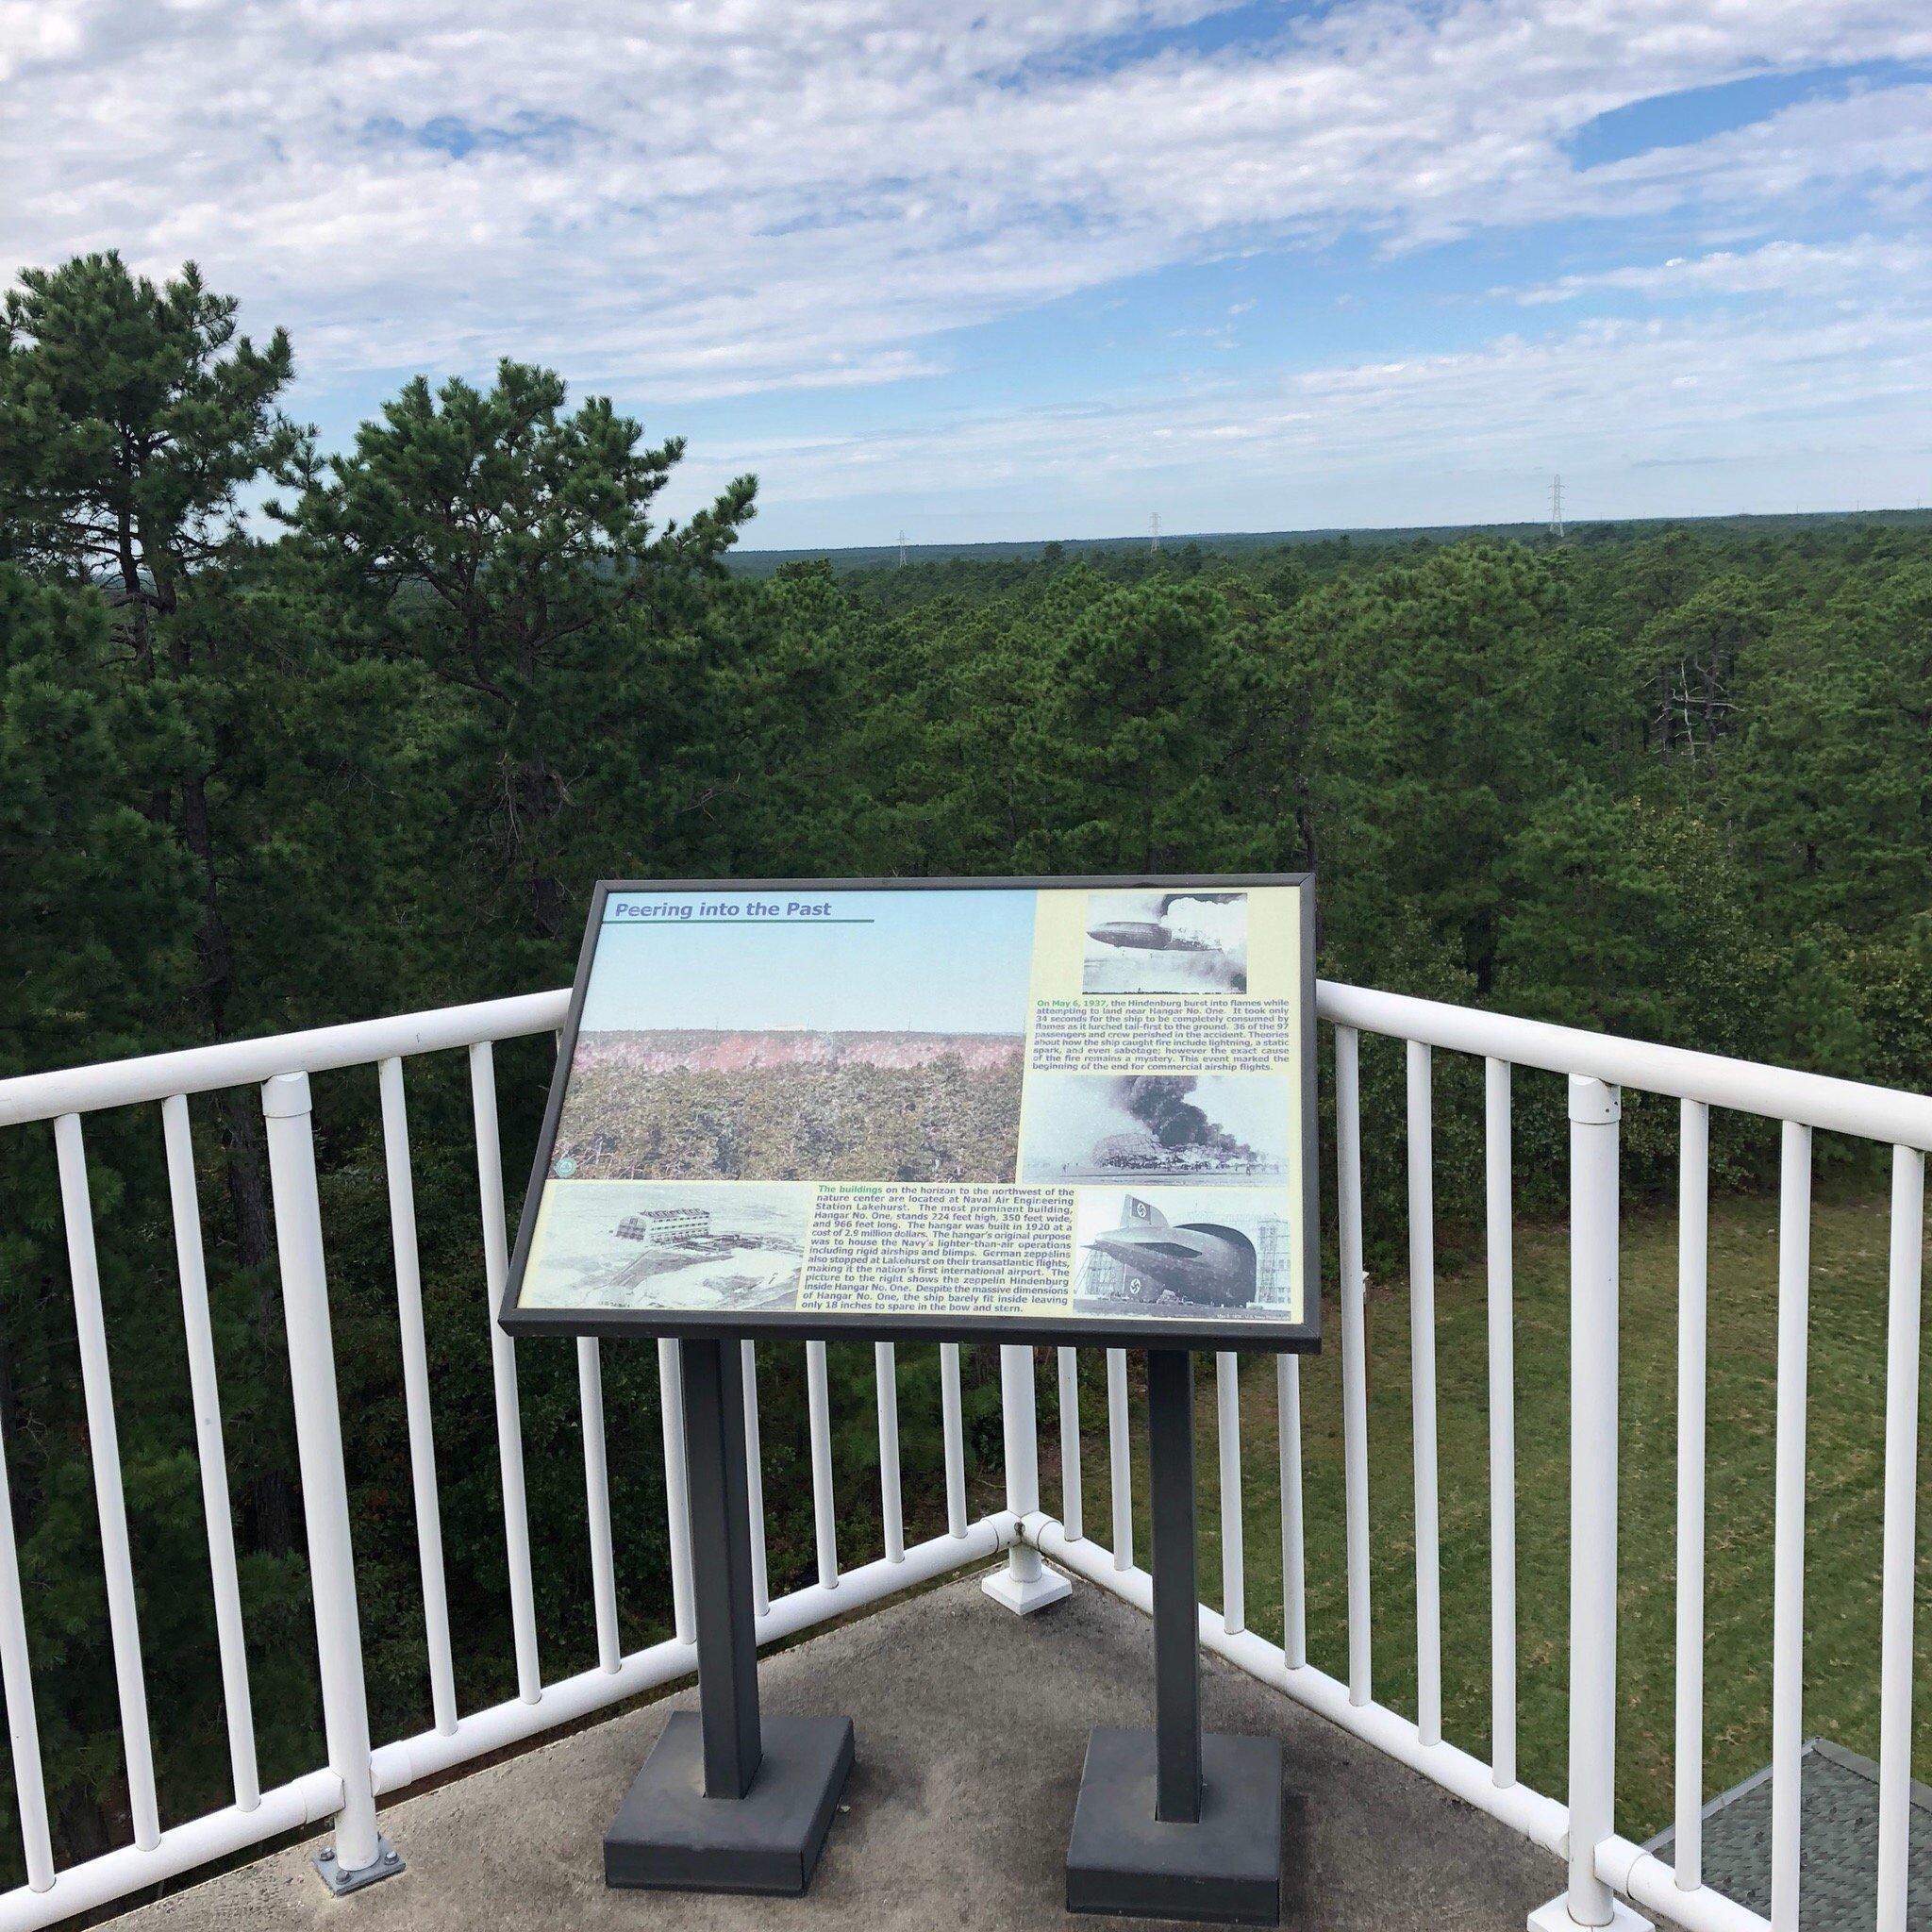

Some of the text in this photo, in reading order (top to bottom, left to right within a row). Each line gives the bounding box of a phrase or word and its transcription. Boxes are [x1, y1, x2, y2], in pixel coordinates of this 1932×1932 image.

[615, 901, 831, 920] Peering into the Past
[1053, 999, 1071, 1008] May
[1073, 999, 1081, 1008] 6,
[1084, 999, 1108, 1008] 1937,
[1128, 999, 1181, 1008] Hindenburg
[1036, 1007, 1087, 1016] attempting
[1150, 1007, 1183, 1016] Hangar
[1269, 1007, 1289, 1016] only
[1124, 1015, 1142, 1024] ship
[1173, 1015, 1224, 1024] completely
[1133, 1030, 1172, 1040] perished
[1101, 1039, 1120, 1047] ship
[1123, 1039, 1154, 1047] caught
[1033, 1046, 1064, 1056] spark,
[1114, 1046, 1163, 1056] sabotage;
[1135, 1054, 1175, 1063] mystery.
[1033, 1062, 1078, 1072] beginning
[1205, 1062, 1237, 1072] airship
[1240, 1063, 1273, 1072] flights.
[820, 1185, 1041, 1195] The buildings horizon northwest
[817, 1193, 849, 1202] nature
[909, 1194, 944, 1203] located
[963, 1195, 991, 1204] Naval
[1014, 1196, 1074, 1207] Engineering
[816, 1202, 852, 1210] Station
[857, 1203, 911, 1211] Lakehurst.
[970, 1204, 1024, 1215] prominent
[1028, 1205, 1074, 1215] building,
[815, 1211, 849, 1221] Hangar
[872, 1211, 892, 1222] One,
[932, 1212, 949, 1221] 224
[953, 1212, 972, 1221] feet
[975, 1213, 998, 1223] high,
[1024, 1213, 1042, 1222] feet
[1046, 1214, 1073, 1224] wide,
[835, 1220, 852, 1228] 966
[856, 1220, 874, 1228] feet
[877, 1221, 901, 1230] long.
[908, 1221, 924, 1229] The
[928, 1221, 962, 1231] hangar
[988, 1222, 1009, 1230] built
[812, 1228, 831, 1237] cost
[894, 1229, 929, 1238] dollars.
[994, 1231, 1030, 1241] original
[1033, 1233, 1071, 1241] purpose
[848, 1238, 877, 1246] house
[938, 1239, 1014, 1250] lighter-than-air
[1018, 1240, 1071, 1250] operations
[809, 1246, 853, 1257] including
[857, 1247, 878, 1257] rigid
[880, 1247, 919, 1257] airships
[942, 1248, 977, 1258] blimps.
[830, 1256, 868, 1266] stopped
[882, 1257, 930, 1265] Lakehurst
[972, 1257, 1034, 1266] transatlantic
[1037, 1258, 1070, 1269] flights,
[808, 1264, 842, 1274] making
[941, 1266, 1004, 1274] international
[1008, 1267, 1045, 1277] airport.
[806, 1274, 841, 1284] picture
[908, 1274, 939, 1283] shows
[964, 1275, 1005, 1286] zeppelin
[1010, 1276, 1069, 1287] Hindenburg
[805, 1282, 832, 1291] inside
[835, 1283, 869, 1293] Hangar
[872, 1283, 887, 1291] No.
[916, 1284, 952, 1294] Despite
[973, 1285, 1011, 1293] massive
[1013, 1286, 1068, 1294] dimensions
[817, 1291, 853, 1302] Hangar
[877, 1292, 900, 1303] One,
[924, 1293, 944, 1304] ship
[948, 1293, 979, 1304] barely
[998, 1294, 1027, 1303] inside
[1032, 1295, 1067, 1306] leaving
[802, 1301, 823, 1310] only
[841, 1301, 872, 1309] inches
[888, 1304, 915, 1312] spare
